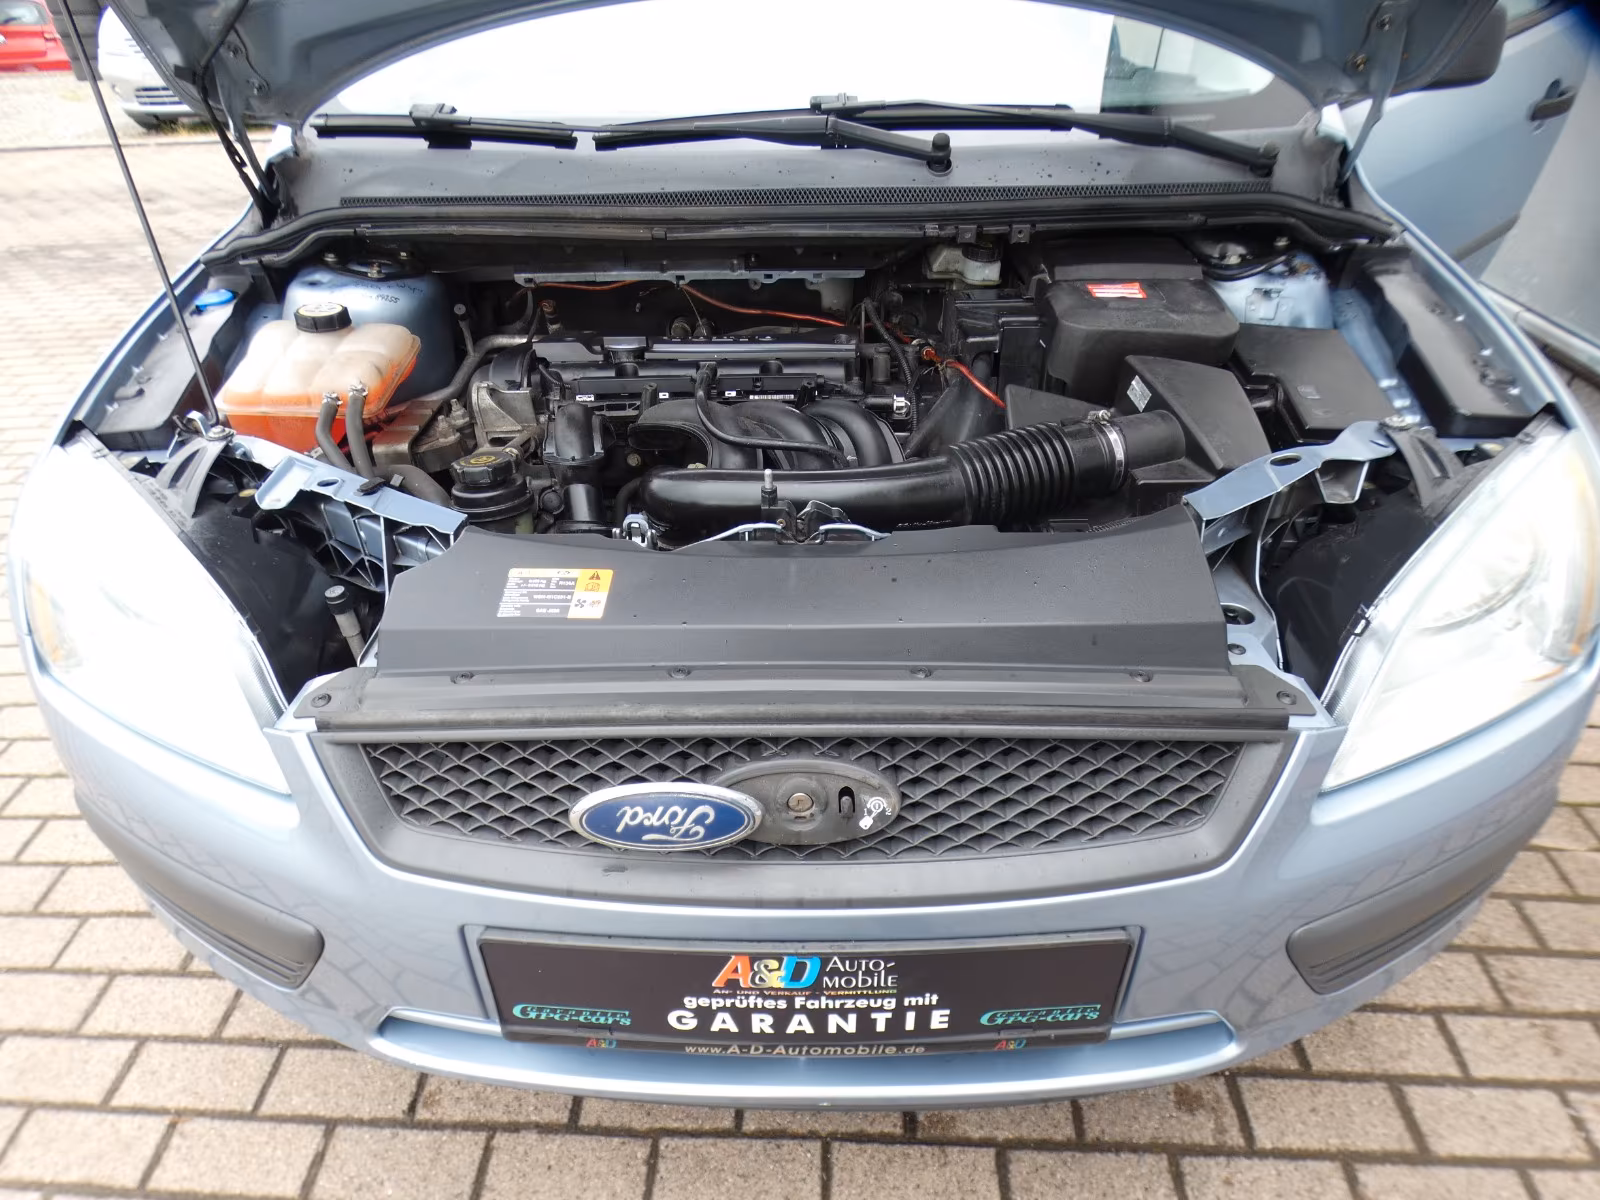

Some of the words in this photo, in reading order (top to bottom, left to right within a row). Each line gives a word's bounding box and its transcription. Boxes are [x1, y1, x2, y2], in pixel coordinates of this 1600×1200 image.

[863, 807, 868, 816] 1
[885, 807, 892, 816] 2
[615, 804, 715, 841] Ford
[711, 954, 821, 989] A&D
[683, 995, 788, 1010] geprüftes
[794, 996, 896, 1010] Fahrzeug
[904, 993, 939, 1006] mit
[667, 1009, 950, 1034] GARANTIE
[685, 1044, 926, 1056] www.A-D-Automobile.de
